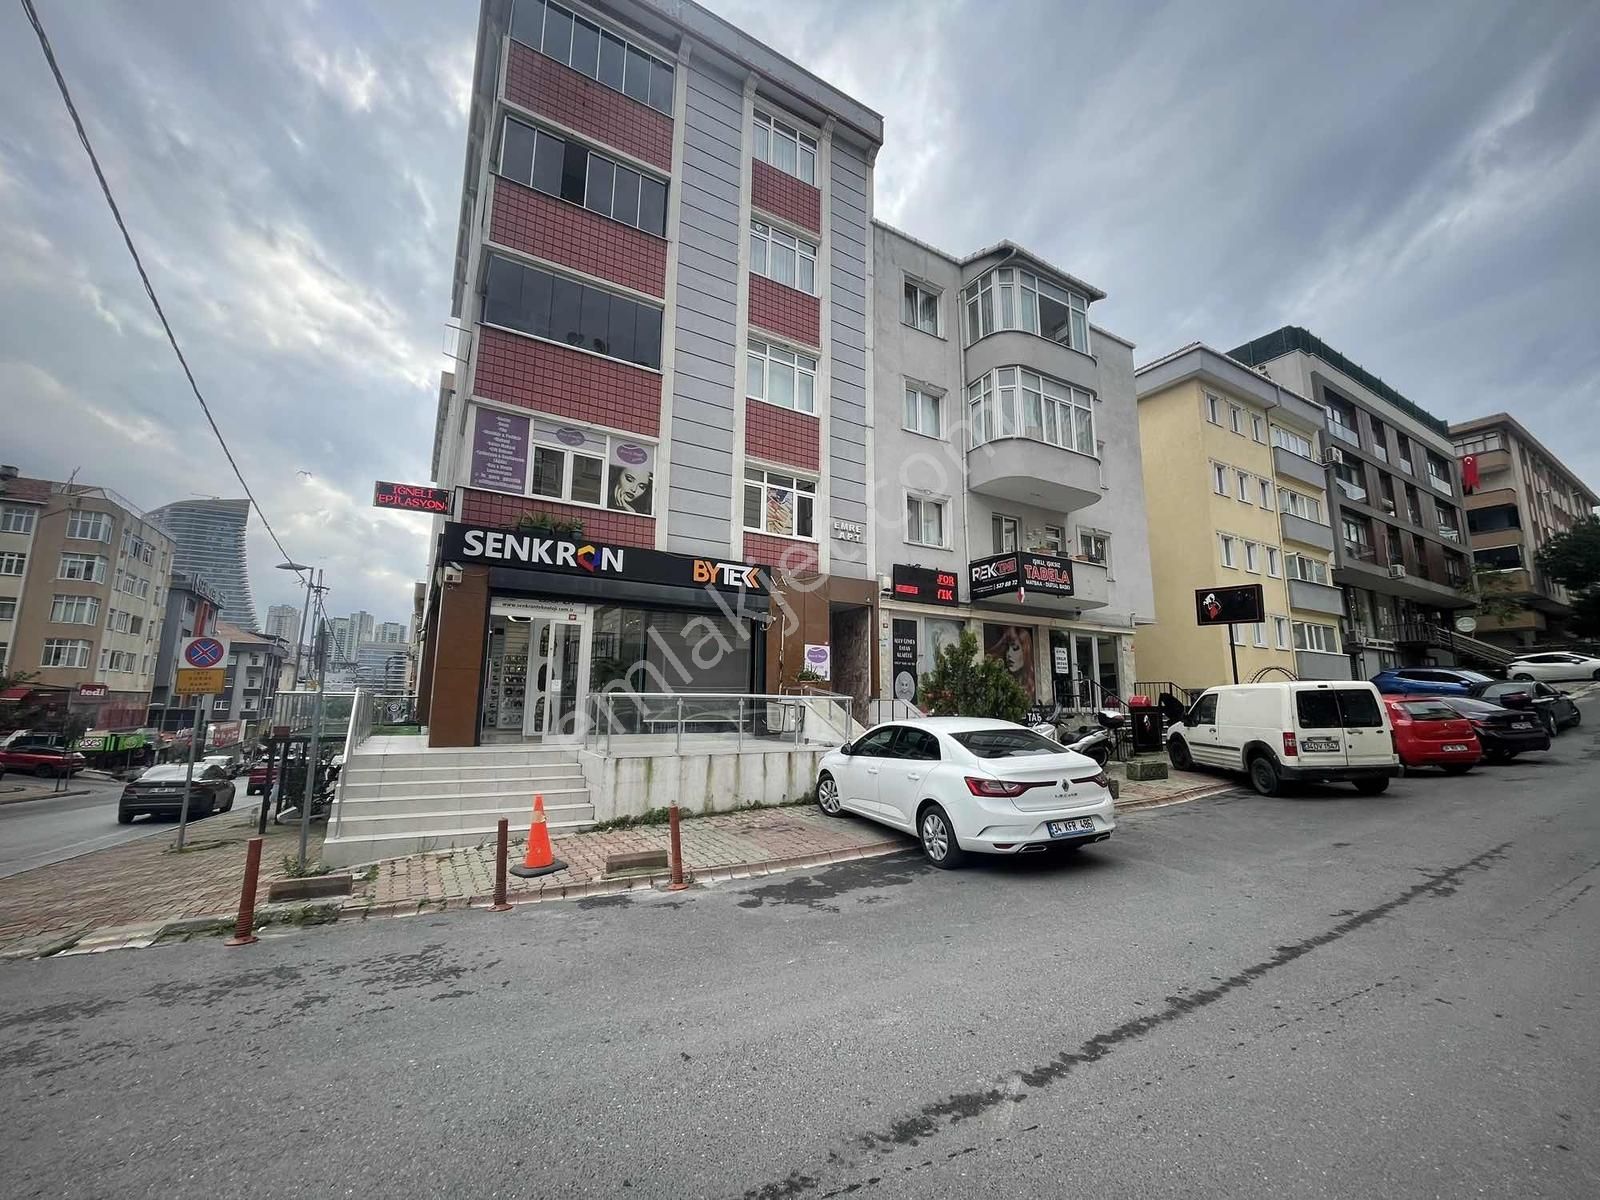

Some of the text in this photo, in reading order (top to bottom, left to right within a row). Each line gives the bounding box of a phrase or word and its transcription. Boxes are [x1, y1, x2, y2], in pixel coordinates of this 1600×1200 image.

[834, 521, 861, 533] EMRE
[839, 531, 862, 541] APT
[462, 530, 624, 574] SENKRON
[1024, 564, 1070, 584] TABELA
[1052, 823, 1063, 834] 34
